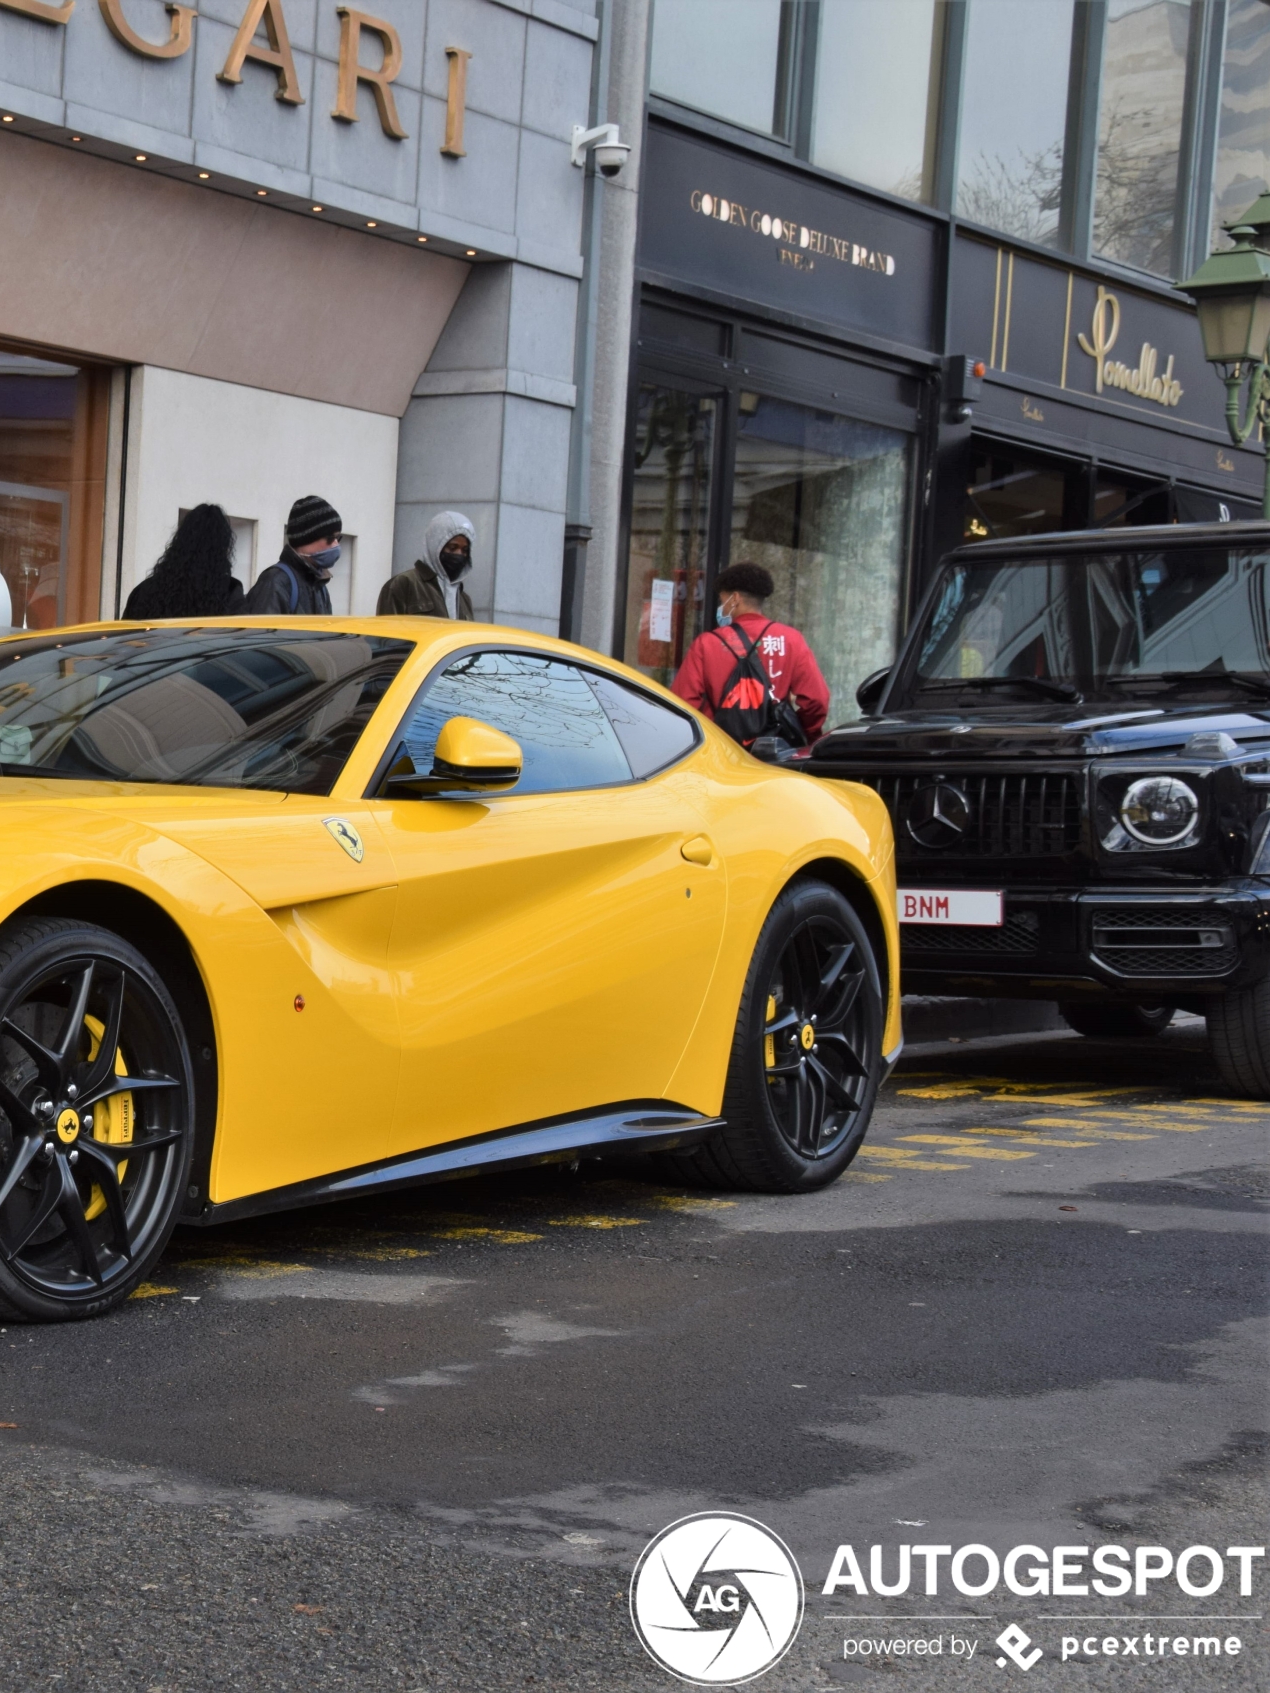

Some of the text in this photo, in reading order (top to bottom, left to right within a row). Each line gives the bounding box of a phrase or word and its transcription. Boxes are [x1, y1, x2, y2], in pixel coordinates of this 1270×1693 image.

[690, 189, 895, 276] GOLDEN GOOSE DELUXE BRAND
[1077, 285, 1185, 407] Pomellato
[904, 895, 949, 919] BNM
